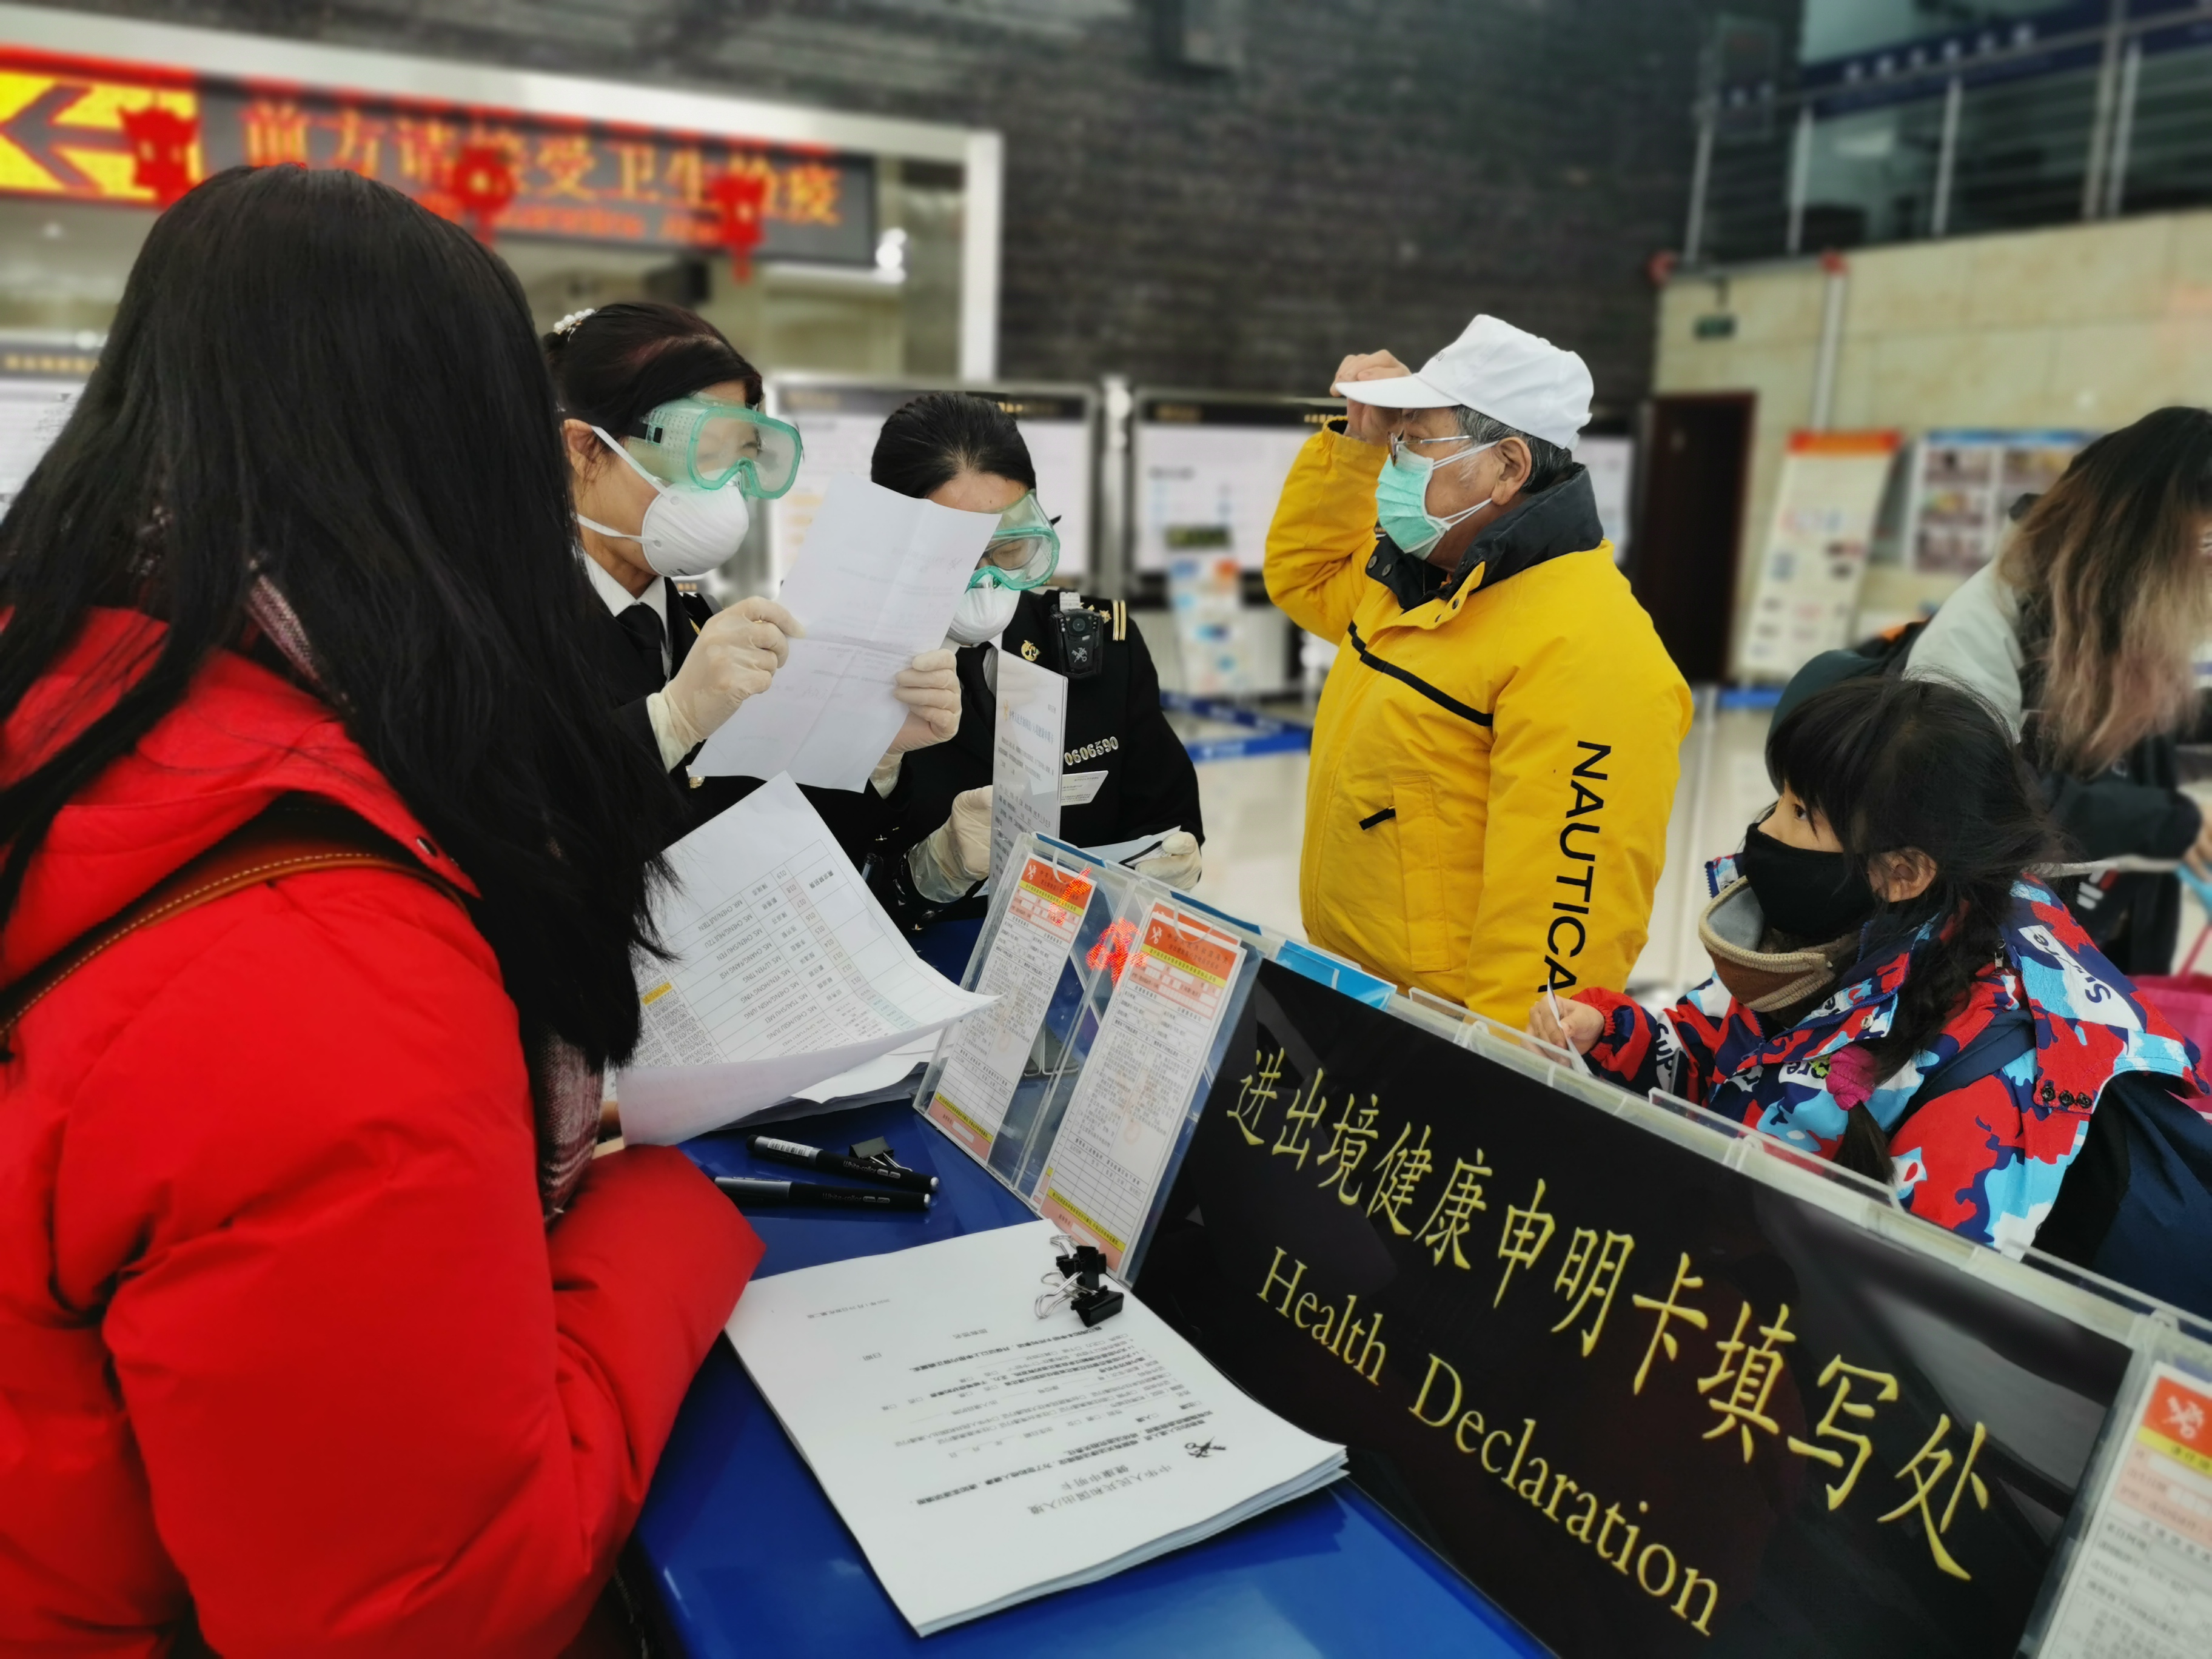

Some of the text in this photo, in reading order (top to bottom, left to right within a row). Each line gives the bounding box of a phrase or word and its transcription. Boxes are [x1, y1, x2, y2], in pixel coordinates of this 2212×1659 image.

[1064, 736, 1119, 766] 0606590
[776, 869, 786, 879] 019
[1538, 740, 1612, 993] NAUTICA
[786, 883, 796, 893] 018
[697, 899, 743, 931] MR. CHEN/JUI TIEN
[795, 898, 806, 908] 017
[805, 911, 816, 921] 016
[703, 913, 752, 948] MS. CHENG/HUI TZU
[814, 925, 825, 934] 015
[823, 938, 834, 948] 014
[715, 927, 762, 961] MS. CHEN/SHU FEN
[832, 951, 843, 960] 013
[719, 941, 772, 979] MS. CHANG/FANG HSI
[742, 954, 781, 983] MS. LI/YEN TING
[841, 963, 852, 973] 012
[739, 967, 790, 1004] MS. YEN/HONG YING
[850, 975, 861, 985] 011
[743, 980, 799, 1019] MS. CHENG/HSIN JUNG
[764, 992, 808, 1023] MS. TSAI/SHU MEI
[806, 1004, 817, 1014] MS.
[766, 1027, 782, 1040] JUNG
[780, 1010, 807, 1031] CHIU/HSIU
[635, 1045, 665, 1067] 2022/05/1
[1227, 1046, 1989, 1581] 进出境健康申明卡填写处
[1257, 1246, 1721, 1636] Health Declaration
[1027, 1463, 1172, 1516] 中华人民共和国出/入境
[1061, 1463, 1128, 1491] 健康申明卡
